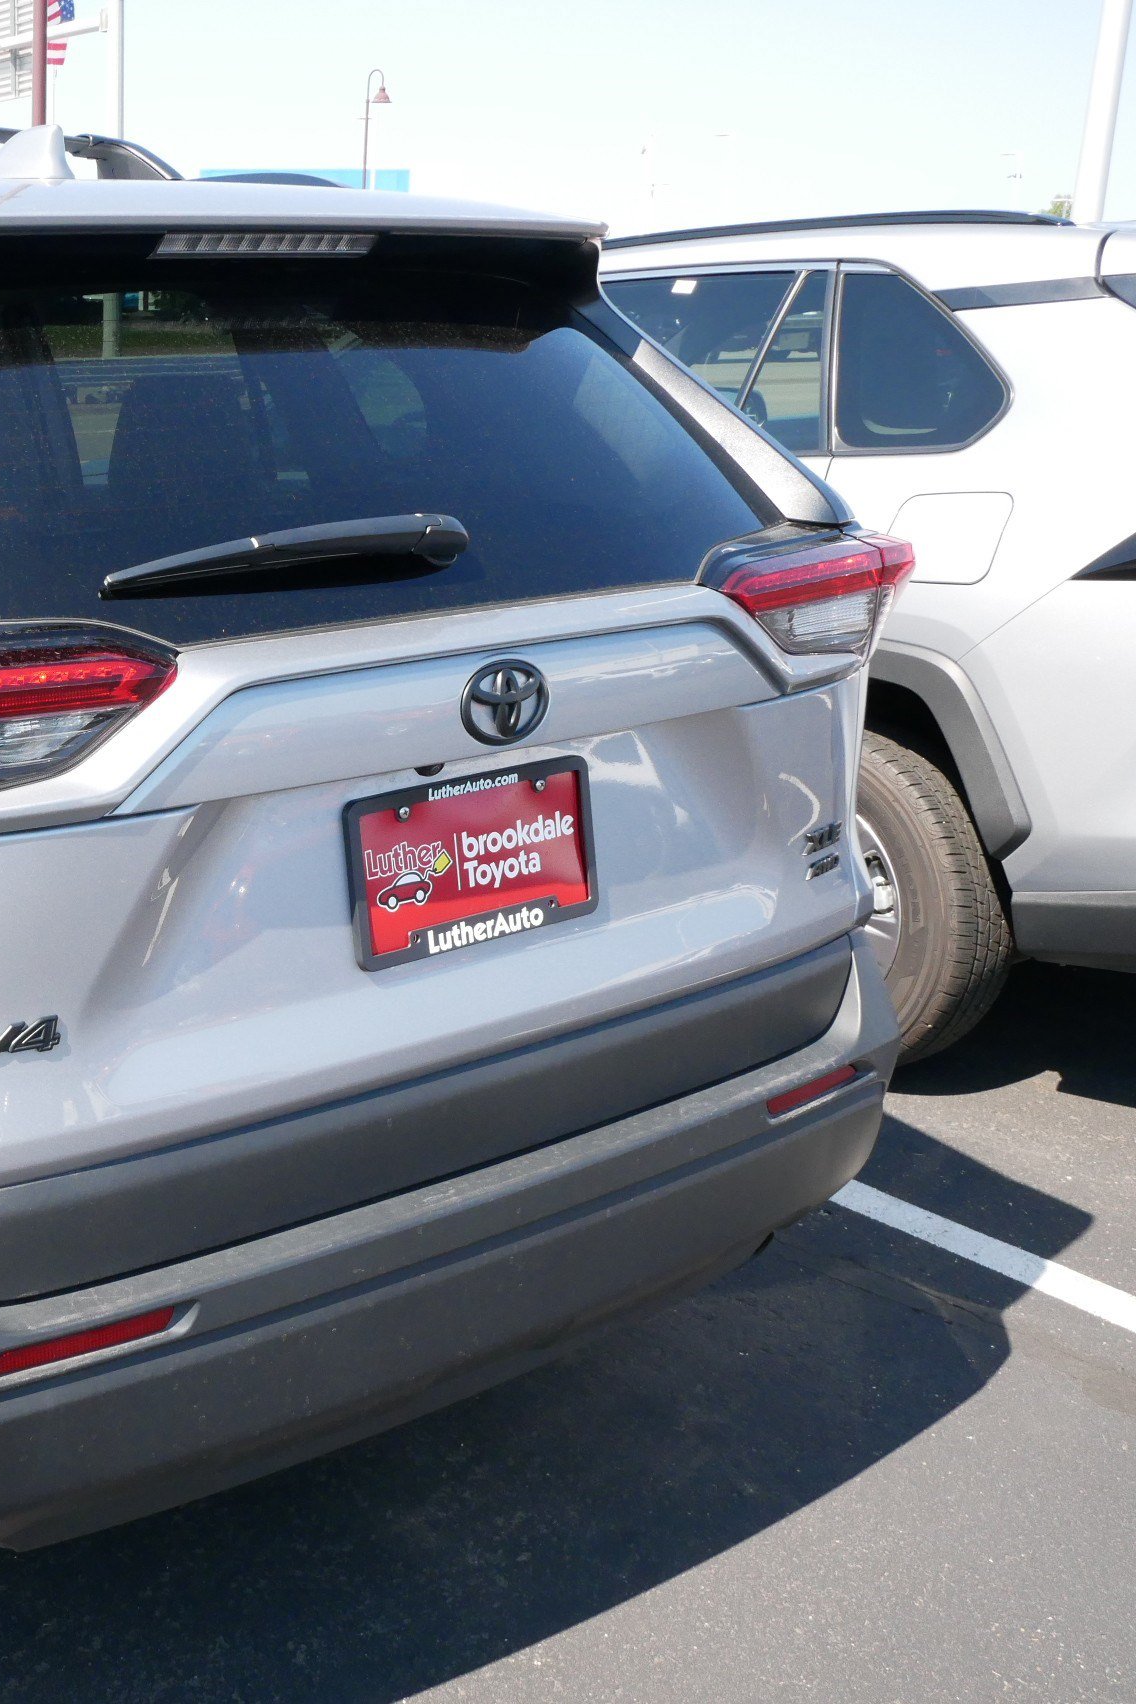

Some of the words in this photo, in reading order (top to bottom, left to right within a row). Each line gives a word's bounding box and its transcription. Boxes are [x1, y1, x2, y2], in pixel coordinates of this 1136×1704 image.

[427, 772, 519, 802] LutherAuto.com
[461, 810, 575, 859] brookdale
[364, 840, 442, 881] Luther
[463, 850, 542, 889] Toyota
[427, 906, 545, 955] LutherAuto
